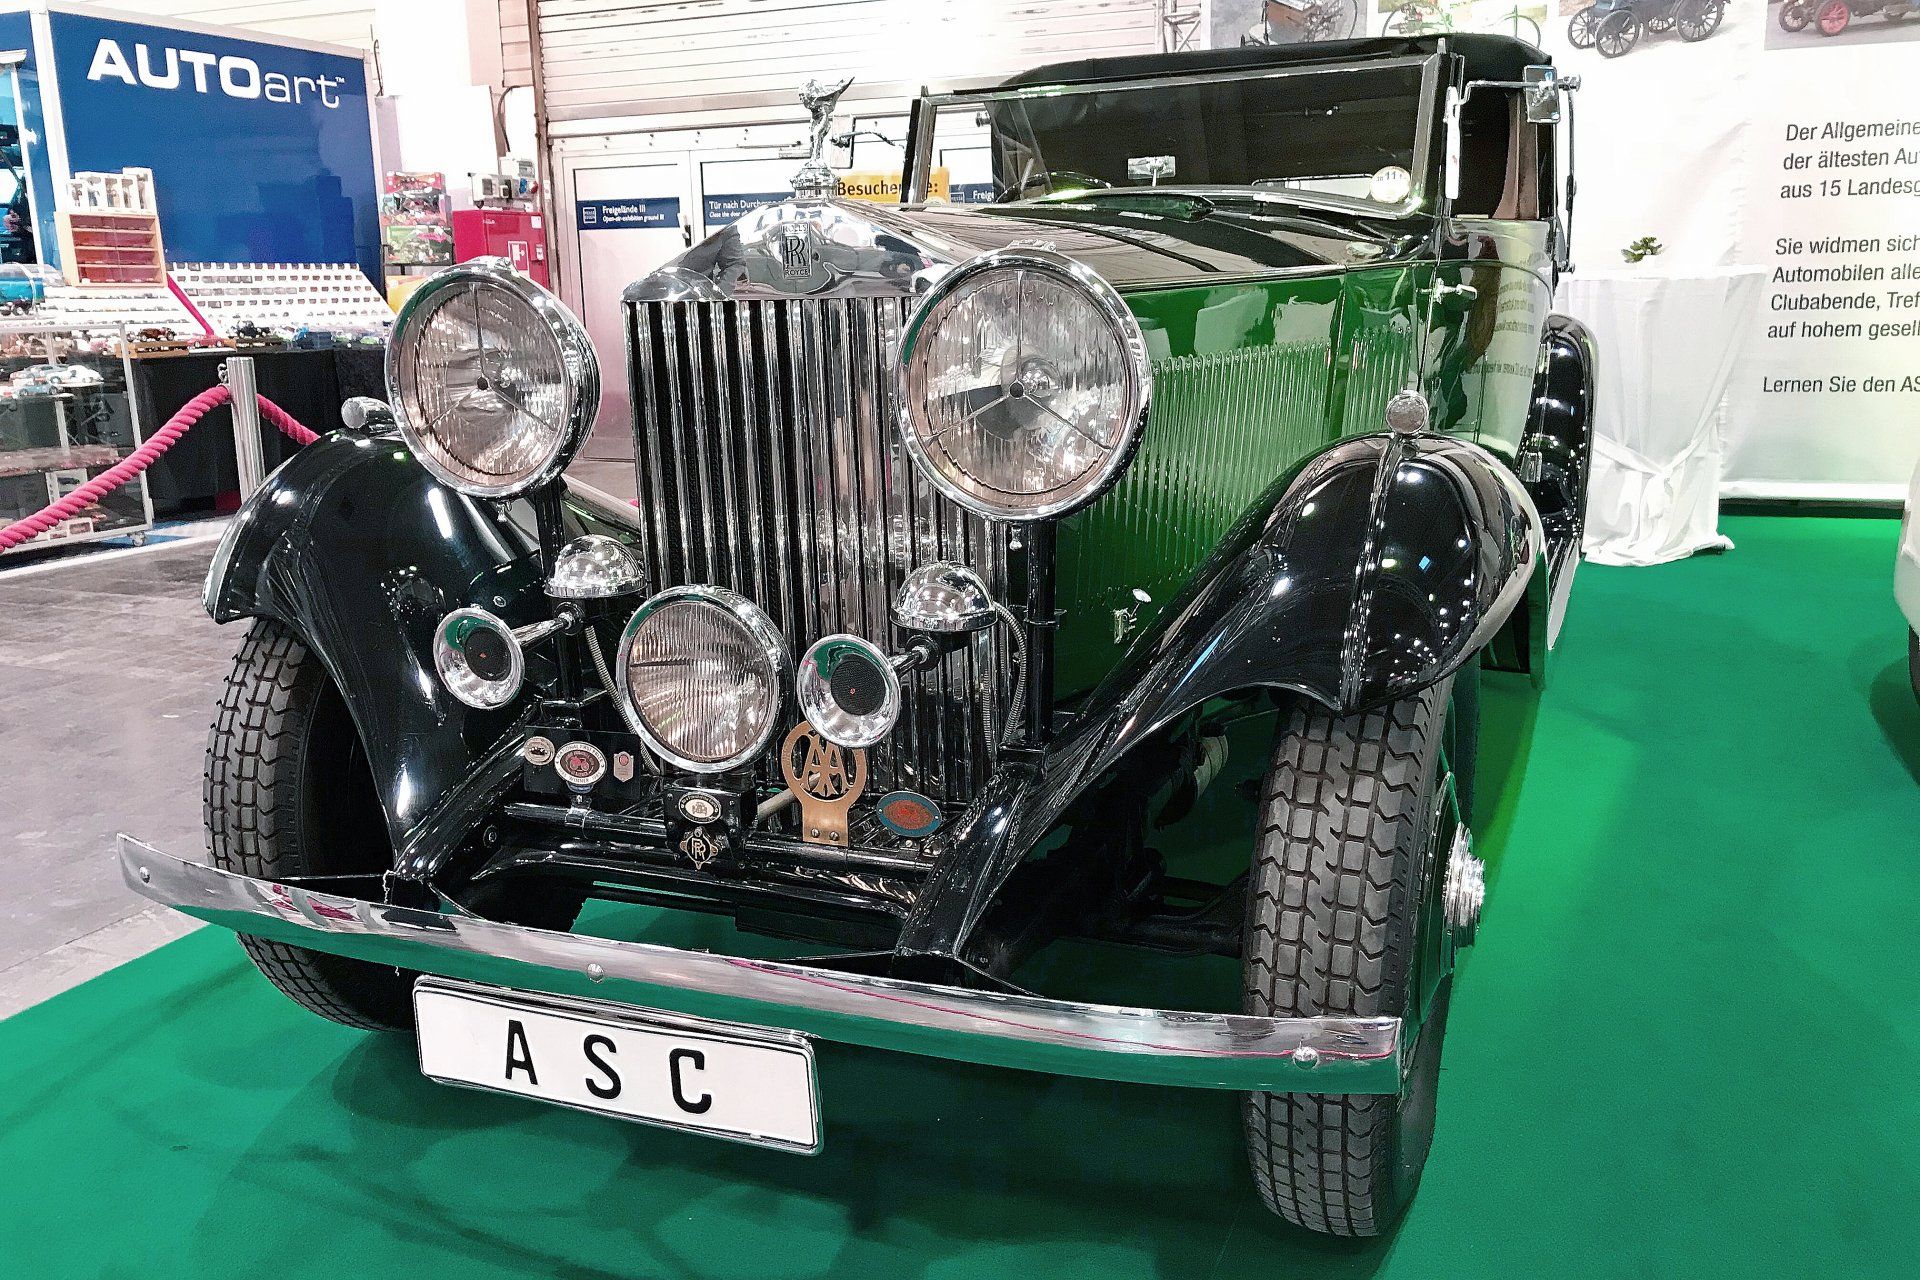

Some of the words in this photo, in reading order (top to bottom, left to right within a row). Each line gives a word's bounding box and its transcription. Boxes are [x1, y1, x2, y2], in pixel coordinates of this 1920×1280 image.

[1785, 124, 1818, 141] Der
[1783, 153, 1813, 170] der
[1818, 150, 1889, 169] ältesten
[1893, 147, 1920, 165] Au
[1780, 184, 1812, 199] aus
[1819, 179, 1842, 197] 15
[602, 205, 638, 216] Freigelände
[708, 201, 721, 210] Tür
[723, 200, 739, 209] nach
[1775, 238, 1803, 255] Sie
[1809, 236, 1880, 254] widmen
[1886, 235, 1920, 252] sich
[1772, 264, 1884, 283] Automobilen
[1771, 292, 1880, 312] Clubabende,
[1767, 321, 1797, 339] auf
[1801, 321, 1862, 338] hohem
[1763, 376, 1823, 393] Lernen
[1829, 376, 1856, 393] Sie
[1863, 376, 1896, 393] den
[504, 1019, 538, 1086] A
[583, 1033, 622, 1100] S
[669, 1047, 713, 1115] C
